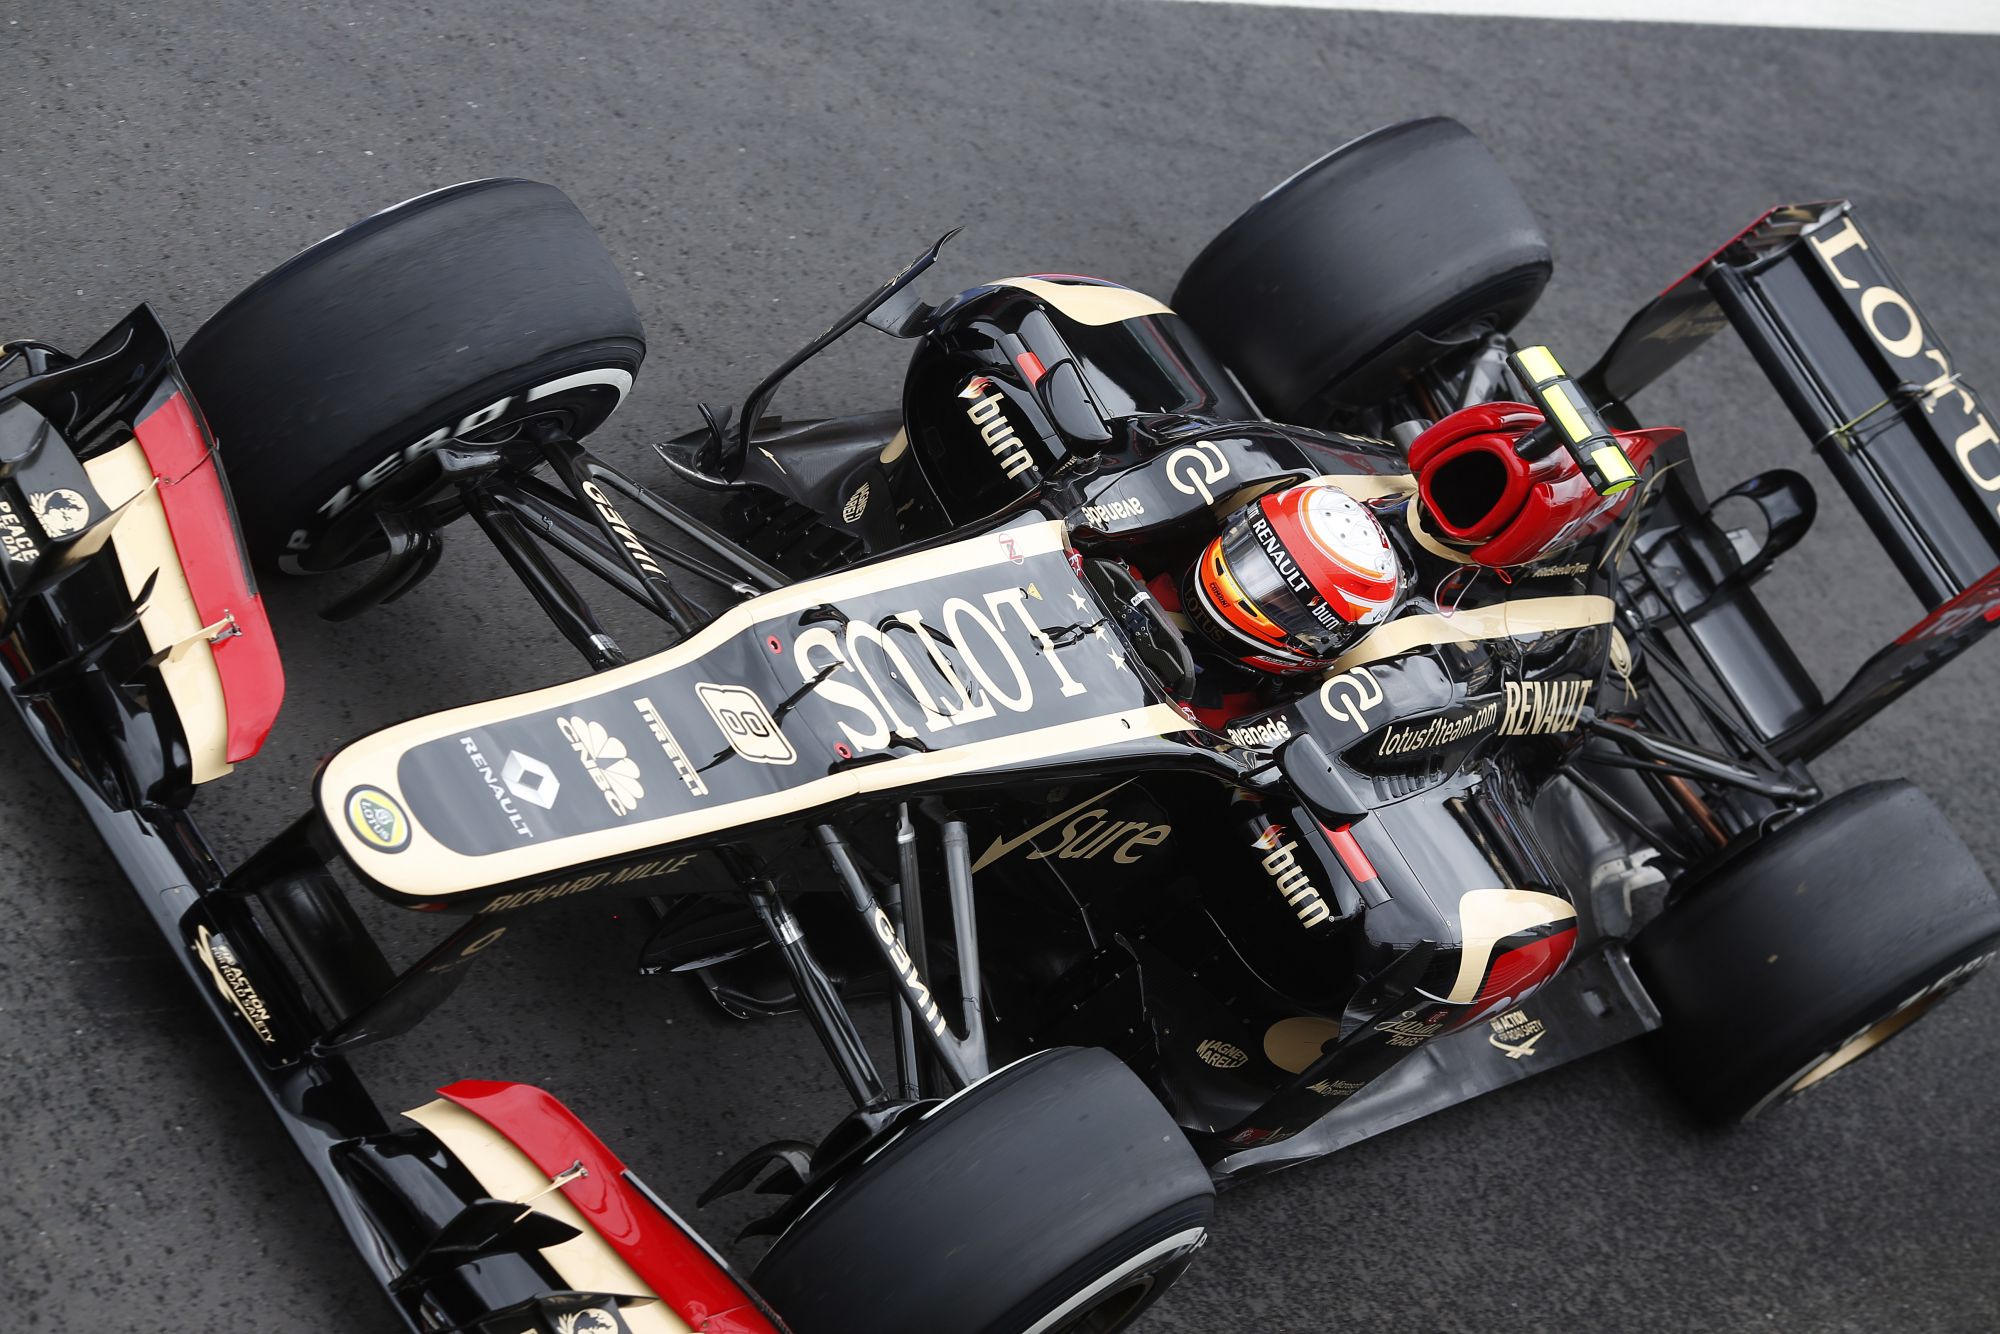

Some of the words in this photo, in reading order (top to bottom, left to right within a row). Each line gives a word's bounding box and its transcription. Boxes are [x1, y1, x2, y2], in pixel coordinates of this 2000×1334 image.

[1810, 217, 2000, 521] LOTU
[967, 392, 1034, 480] burn
[0, 501, 40, 562] PEACE
[1081, 497, 1145, 529] avanade
[1, 535, 25, 562] DAY
[1252, 518, 1309, 593] RENAULT
[1312, 602, 1341, 631] burn
[793, 587, 1088, 752] LOTUS
[1228, 716, 1291, 746] avanade
[1378, 702, 1497, 756] lotusf1team.com
[1499, 680, 1593, 736] RENAULT
[557, 716, 628, 816] CNBC
[633, 697, 708, 797] PIRELLI
[460, 736, 534, 838] RENAULT
[361, 801, 391, 840] LOTUS
[1026, 808, 1172, 864] Sure
[480, 872, 609, 914] RICHARD
[604, 854, 698, 887] MILLE
[1262, 841, 1330, 928] burn
[220, 964, 246, 998] ROAD
[242, 998, 276, 1042] SAFETY
[229, 966, 271, 1020] ACTION
